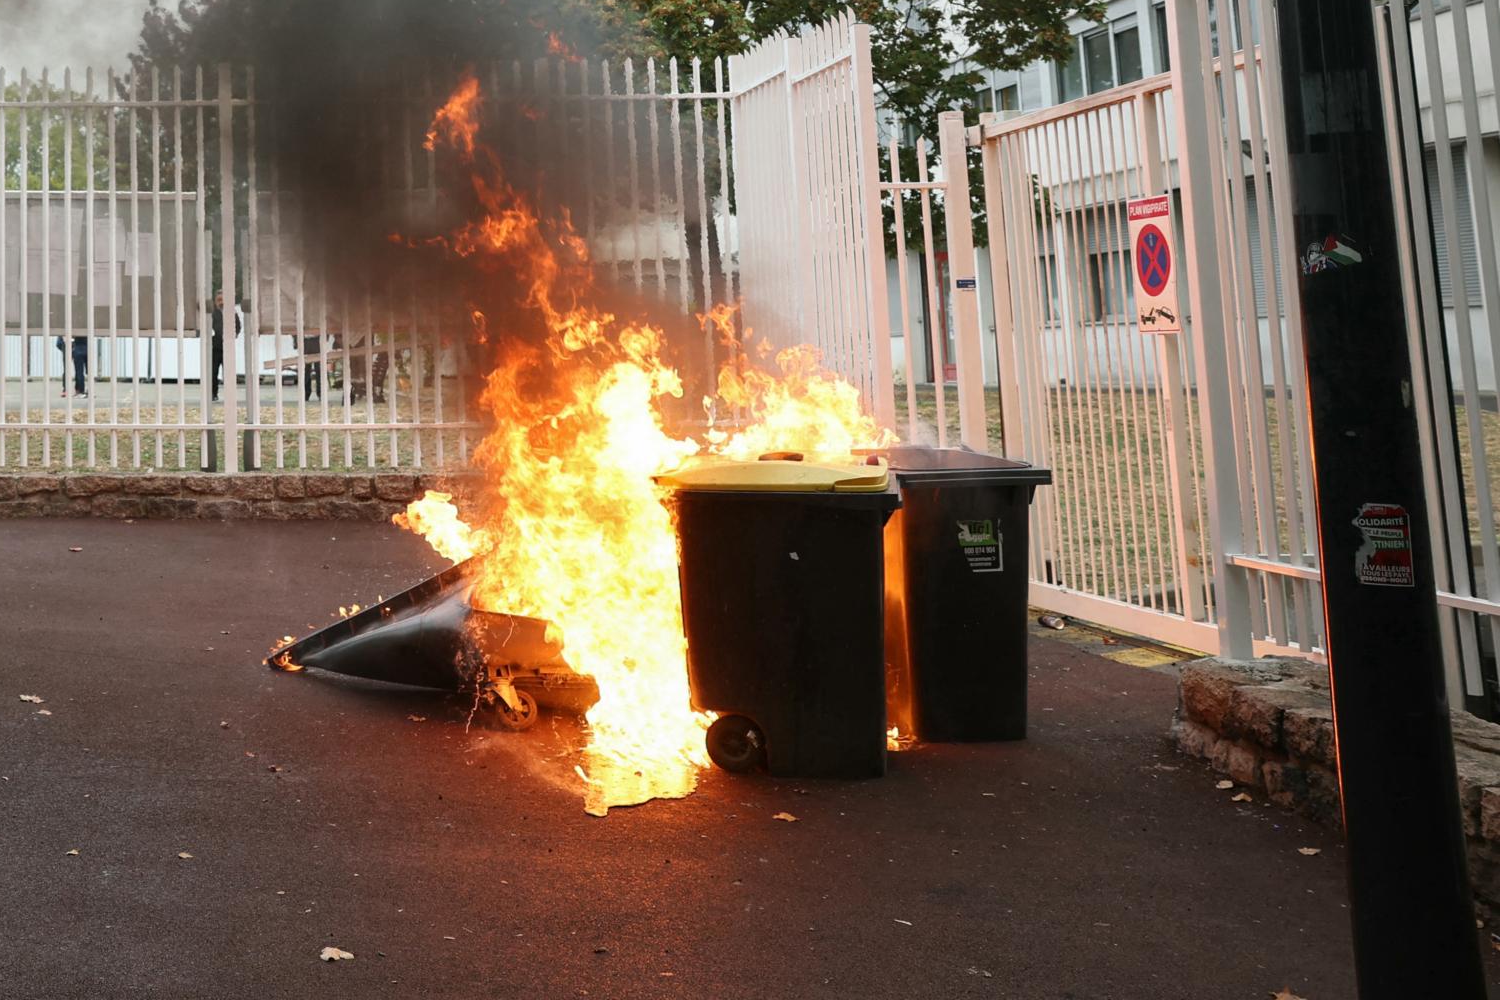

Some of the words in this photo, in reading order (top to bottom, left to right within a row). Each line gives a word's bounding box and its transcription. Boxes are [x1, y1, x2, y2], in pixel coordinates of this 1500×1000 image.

[1130, 205, 1142, 216] PLAN
[1142, 201, 1168, 214] VIGIPIRATE
[1358, 517, 1405, 526] OLIDARITÉ
[1372, 540, 1405, 549] STINIEN
[1363, 563, 1410, 572] AVAILLEURS
